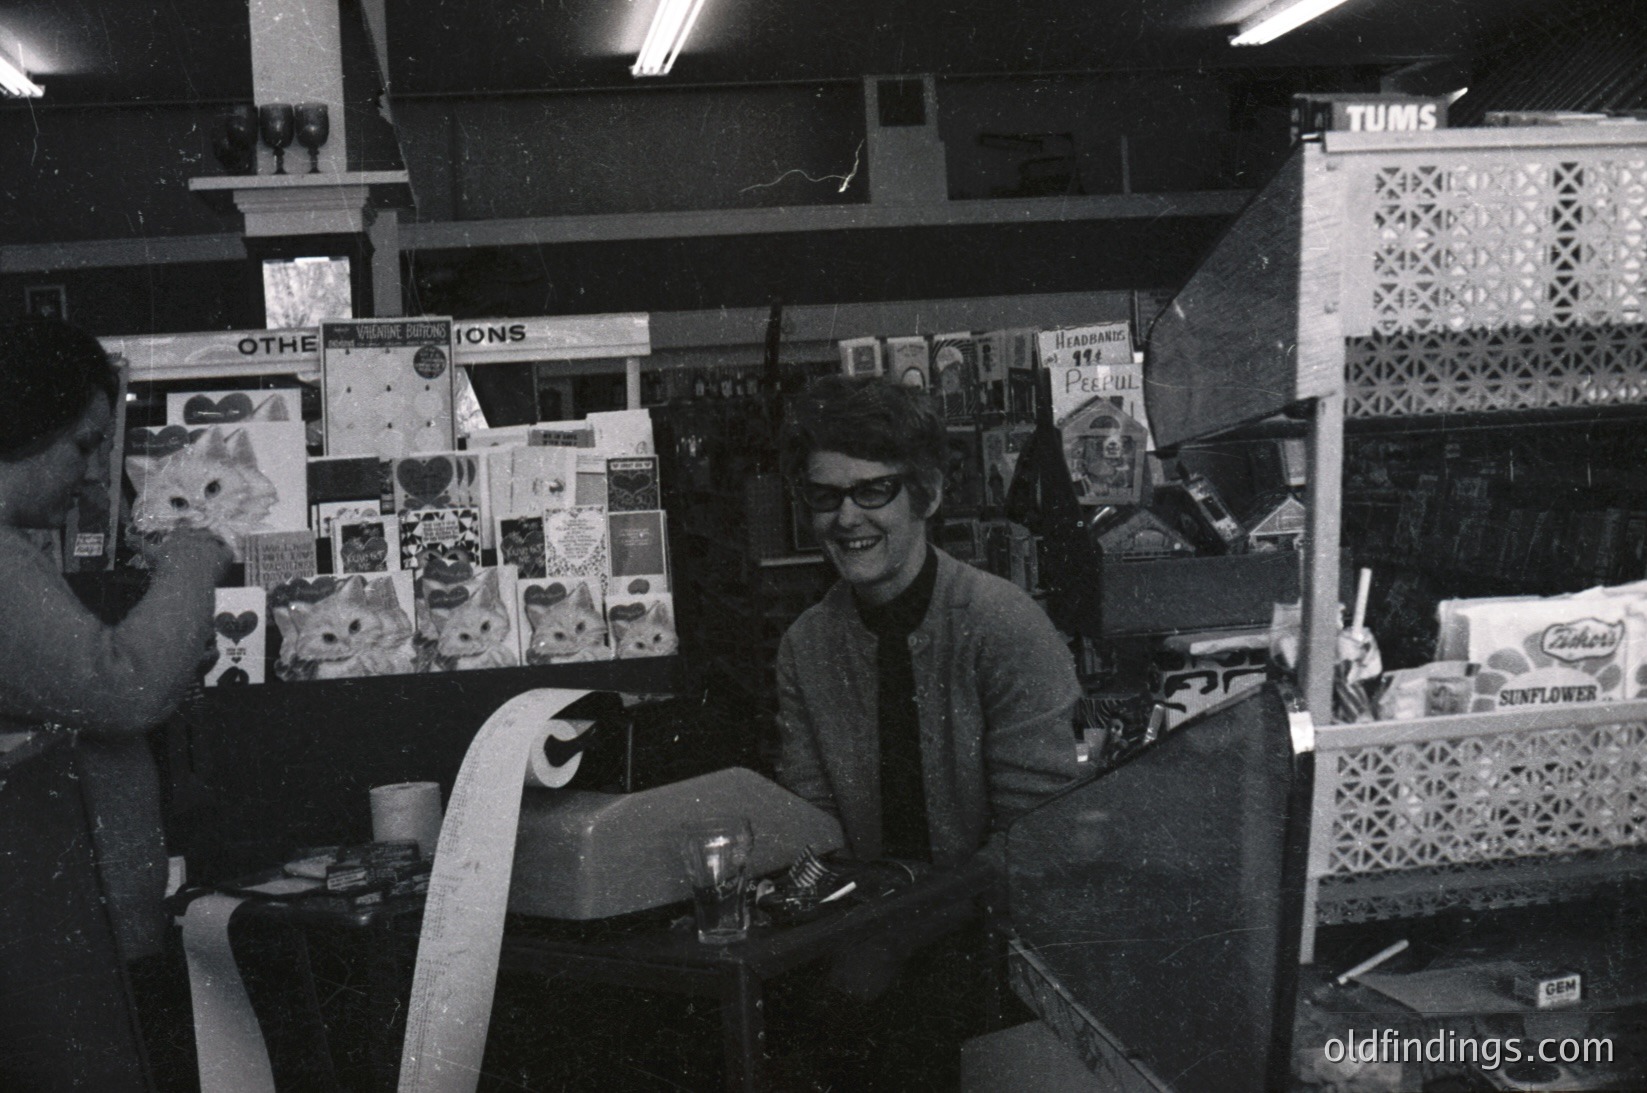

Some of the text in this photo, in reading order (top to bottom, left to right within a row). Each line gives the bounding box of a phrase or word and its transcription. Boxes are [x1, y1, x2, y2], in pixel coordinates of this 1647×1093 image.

[1346, 104, 1437, 131] TUMS
[406, 322, 446, 338] BUTTONS
[1056, 330, 1126, 349] HEADBANDS
[1066, 369, 1139, 393] PEEPUL
[1499, 685, 1597, 706] SUNFLOWER
[1545, 979, 1576, 996] GEM
